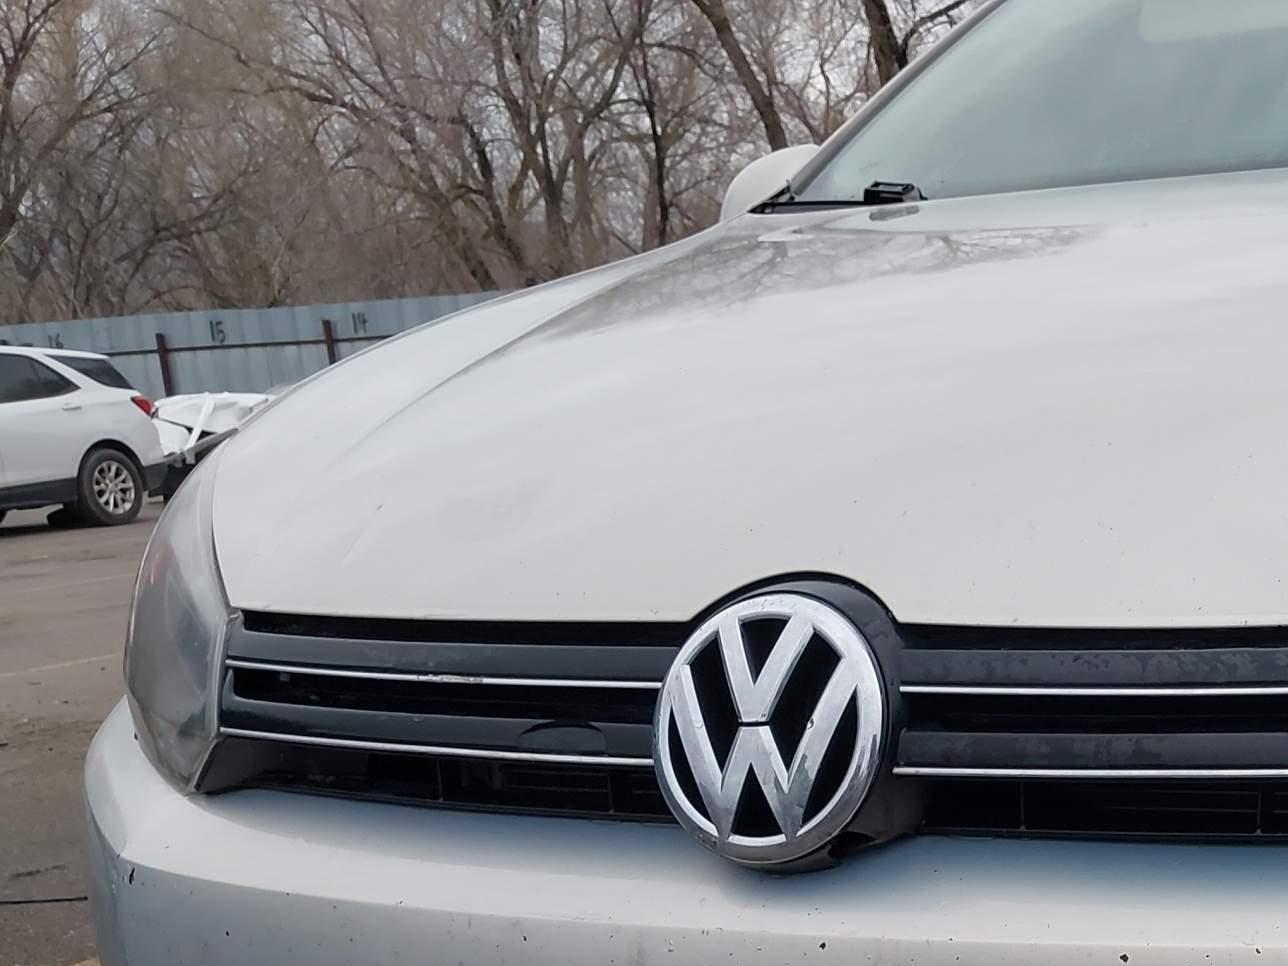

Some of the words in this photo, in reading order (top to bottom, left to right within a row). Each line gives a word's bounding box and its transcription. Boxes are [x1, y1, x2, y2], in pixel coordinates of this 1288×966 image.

[209, 320, 226, 344] 15
[351, 311, 368, 335] 14
[658, 598, 880, 858] VW
